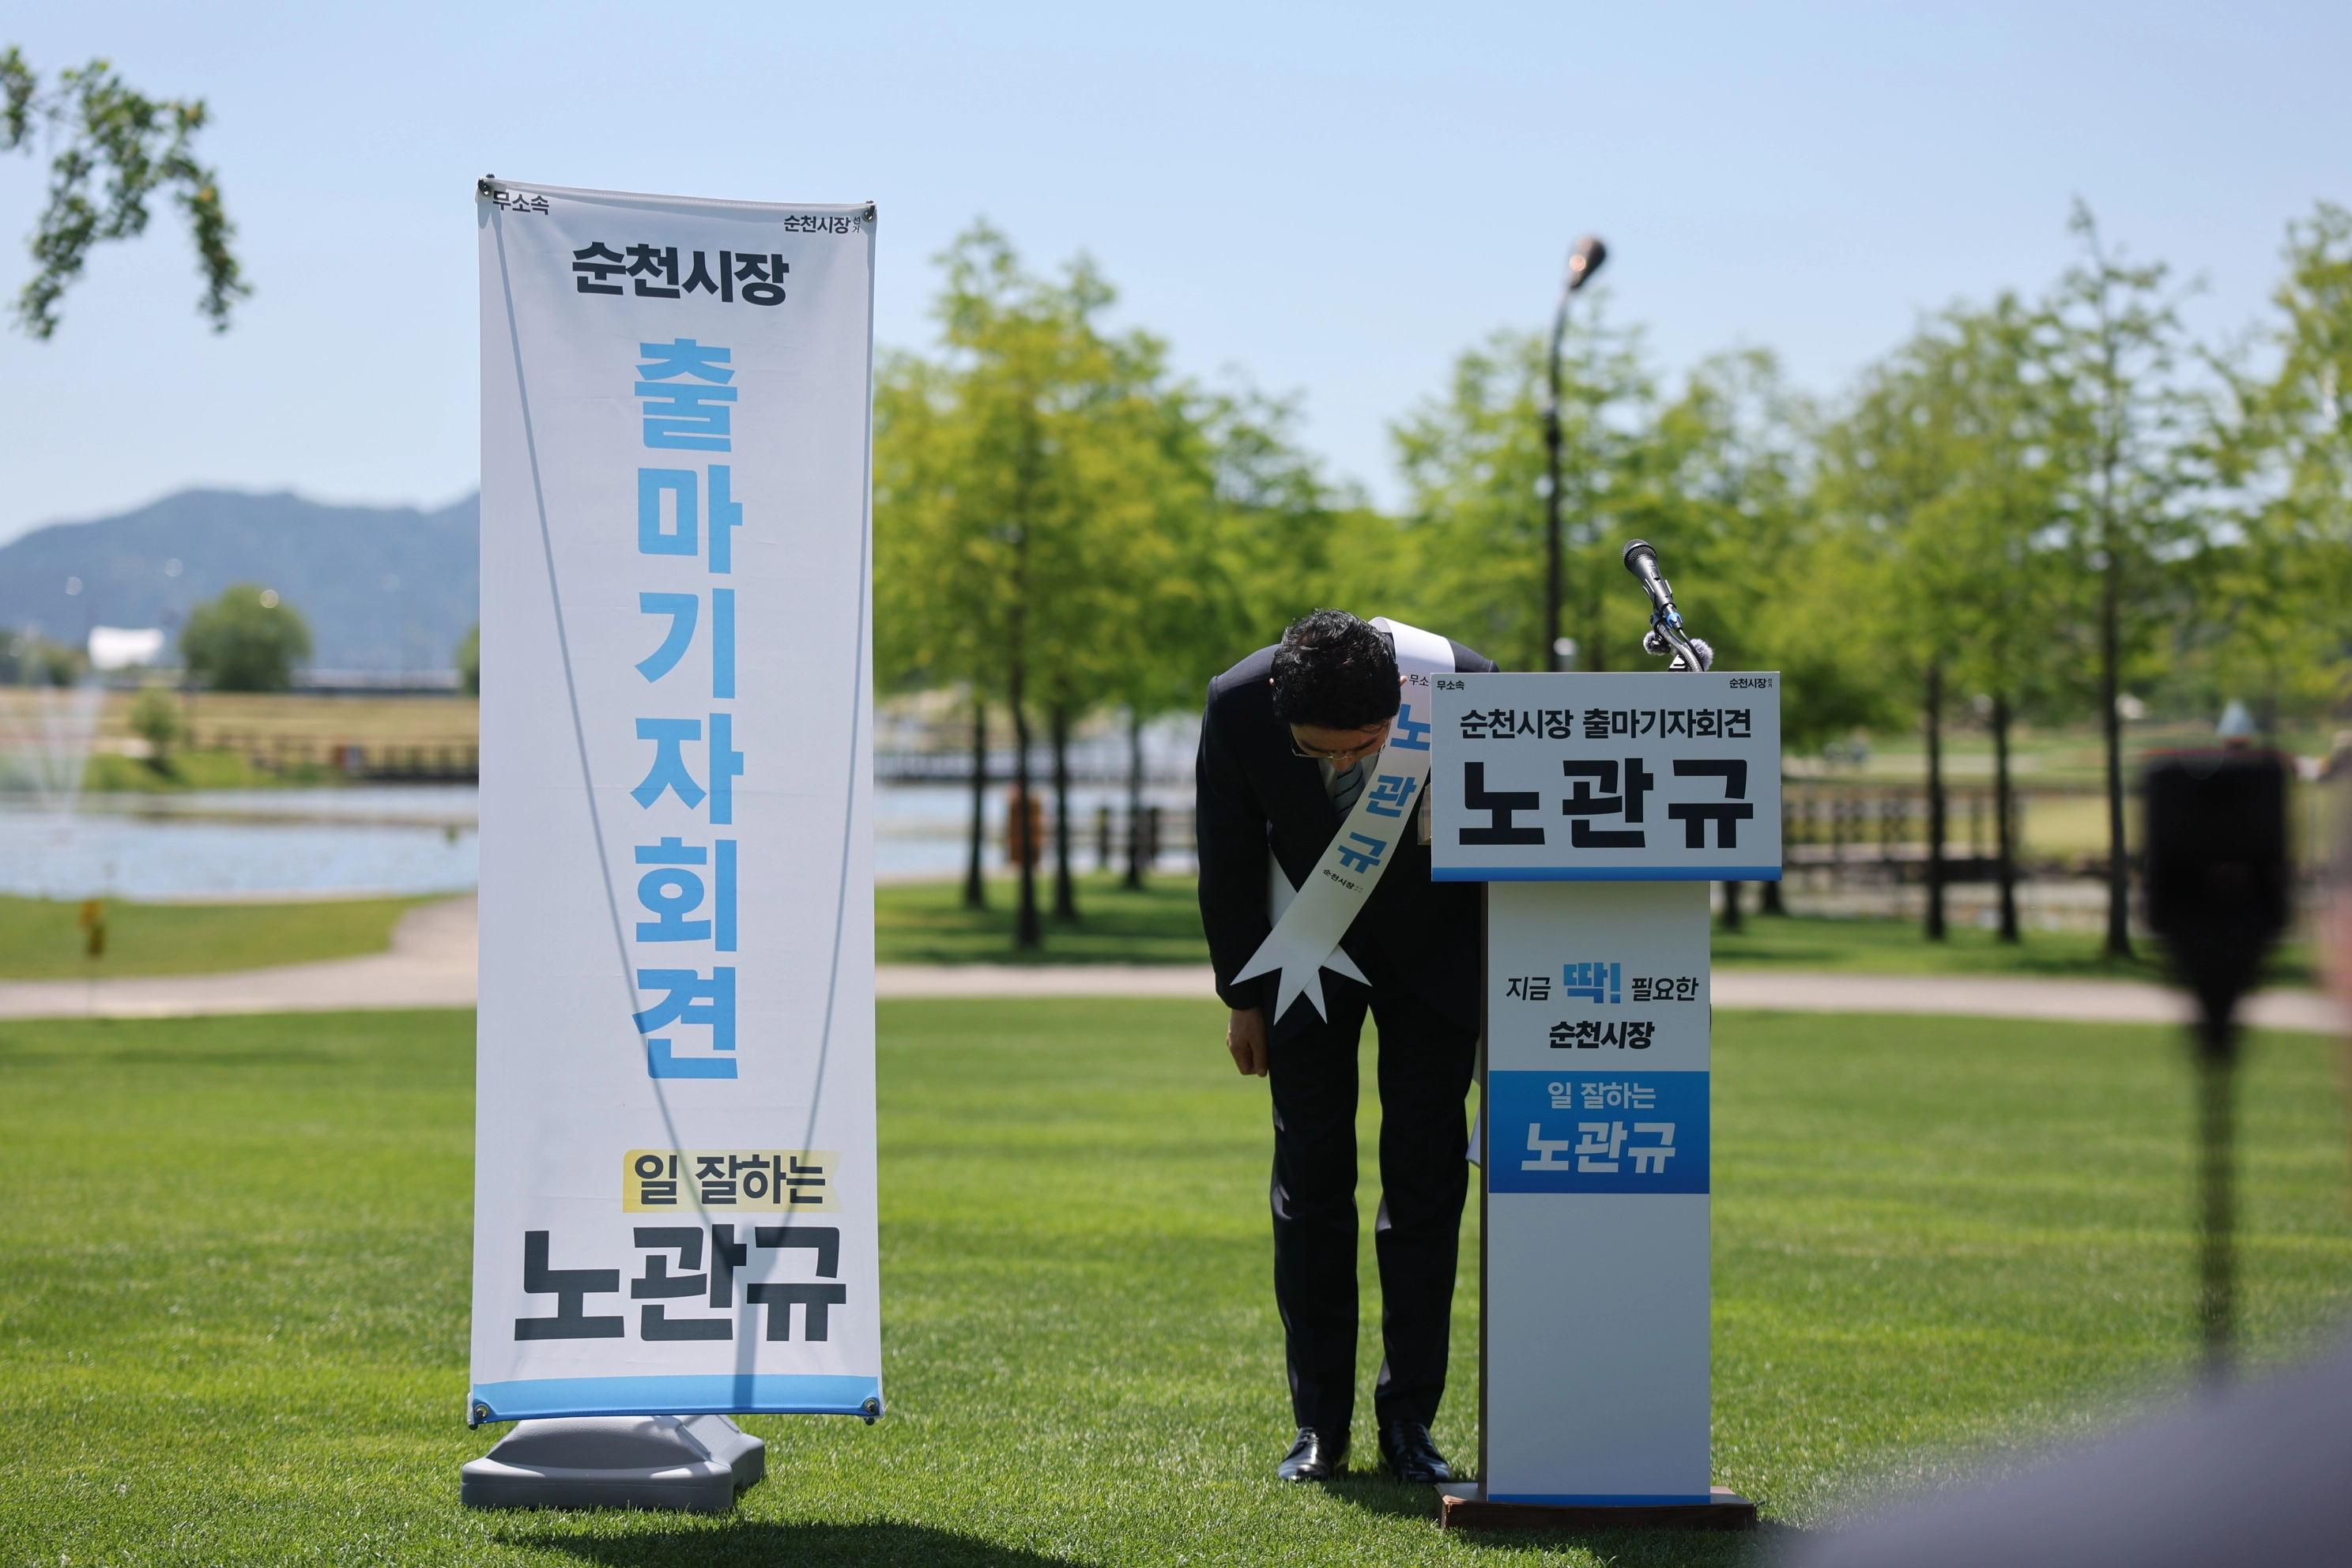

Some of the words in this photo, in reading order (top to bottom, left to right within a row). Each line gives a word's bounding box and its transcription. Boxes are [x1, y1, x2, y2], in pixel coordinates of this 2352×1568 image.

[493, 190, 549, 216] 무소속
[784, 215, 851, 234] 순천시장
[572, 241, 790, 307] 순천시장
[1409, 674, 1430, 687] 무소
[1437, 680, 1464, 691] 무소속
[1729, 678, 1766, 688] 순천시장
[630, 337, 744, 1080] 출마기자회견
[1460, 708, 1574, 739] 순천시장
[1582, 708, 1751, 739] 출마기자회견
[1459, 758, 1754, 849] 노관규
[1323, 869, 1355, 890] 순천시장
[1506, 977, 1551, 1001] 지금
[1563, 962, 1621, 1004] 딱!
[1631, 976, 1699, 1001] 필요한
[1549, 1020, 1655, 1050] 순천시장
[1547, 1082, 1572, 1109] 일
[1581, 1082, 1657, 1109] 잘하는
[1521, 1121, 1676, 1174] 노관규
[634, 1154, 678, 1205] 일
[695, 1154, 826, 1205] 잘하는
[514, 1223, 847, 1342] 노관규
